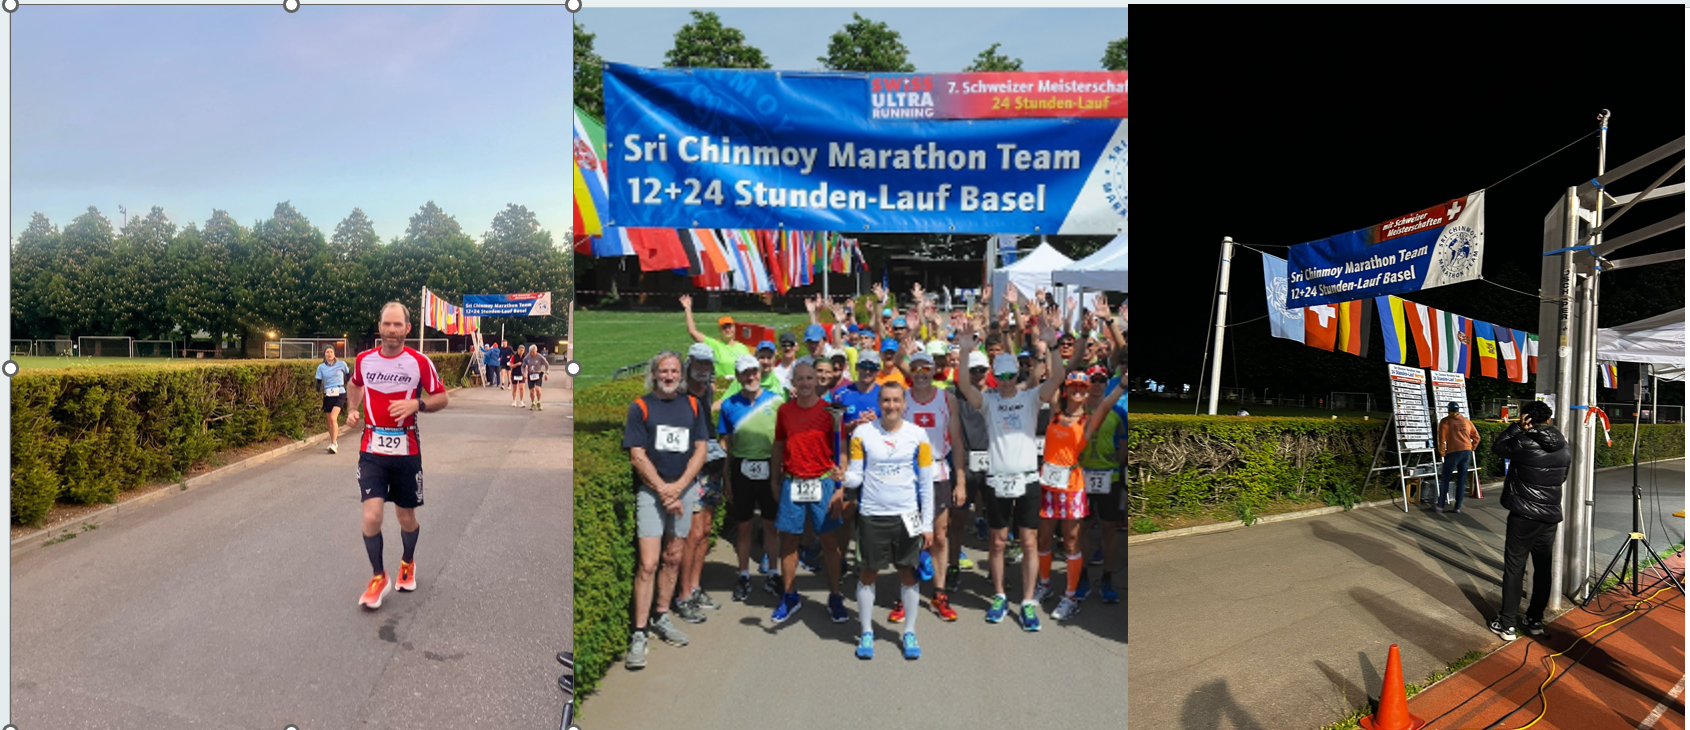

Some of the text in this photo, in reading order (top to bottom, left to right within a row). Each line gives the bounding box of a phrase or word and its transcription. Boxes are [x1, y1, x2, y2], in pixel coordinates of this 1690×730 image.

[947, 82, 960, 94] 7.
[962, 79, 1034, 94] Schweizer
[871, 92, 934, 107] ULTRA
[991, 96, 1111, 110] 24 Stunden-Lauf
[873, 107, 934, 119] RUNNING
[624, 133, 1081, 174] Sri Chinmoy Marathon Team
[627, 177, 1046, 212] 12+24 Stunden-Lauf Basel
[1382, 213, 1428, 231] mit Schweizer
[1387, 217, 1443, 237] Meisterschaften
[1448, 225, 1477, 239] CHINMOY
[1291, 245, 1428, 283] Sri Chinmoy Marathon Team
[1438, 250, 1479, 279] MARATHON TEAM
[1291, 264, 1416, 300] 12+24 Stunden-Lauf Basel
[376, 372, 412, 383] hütten
[378, 436, 401, 449] 129
